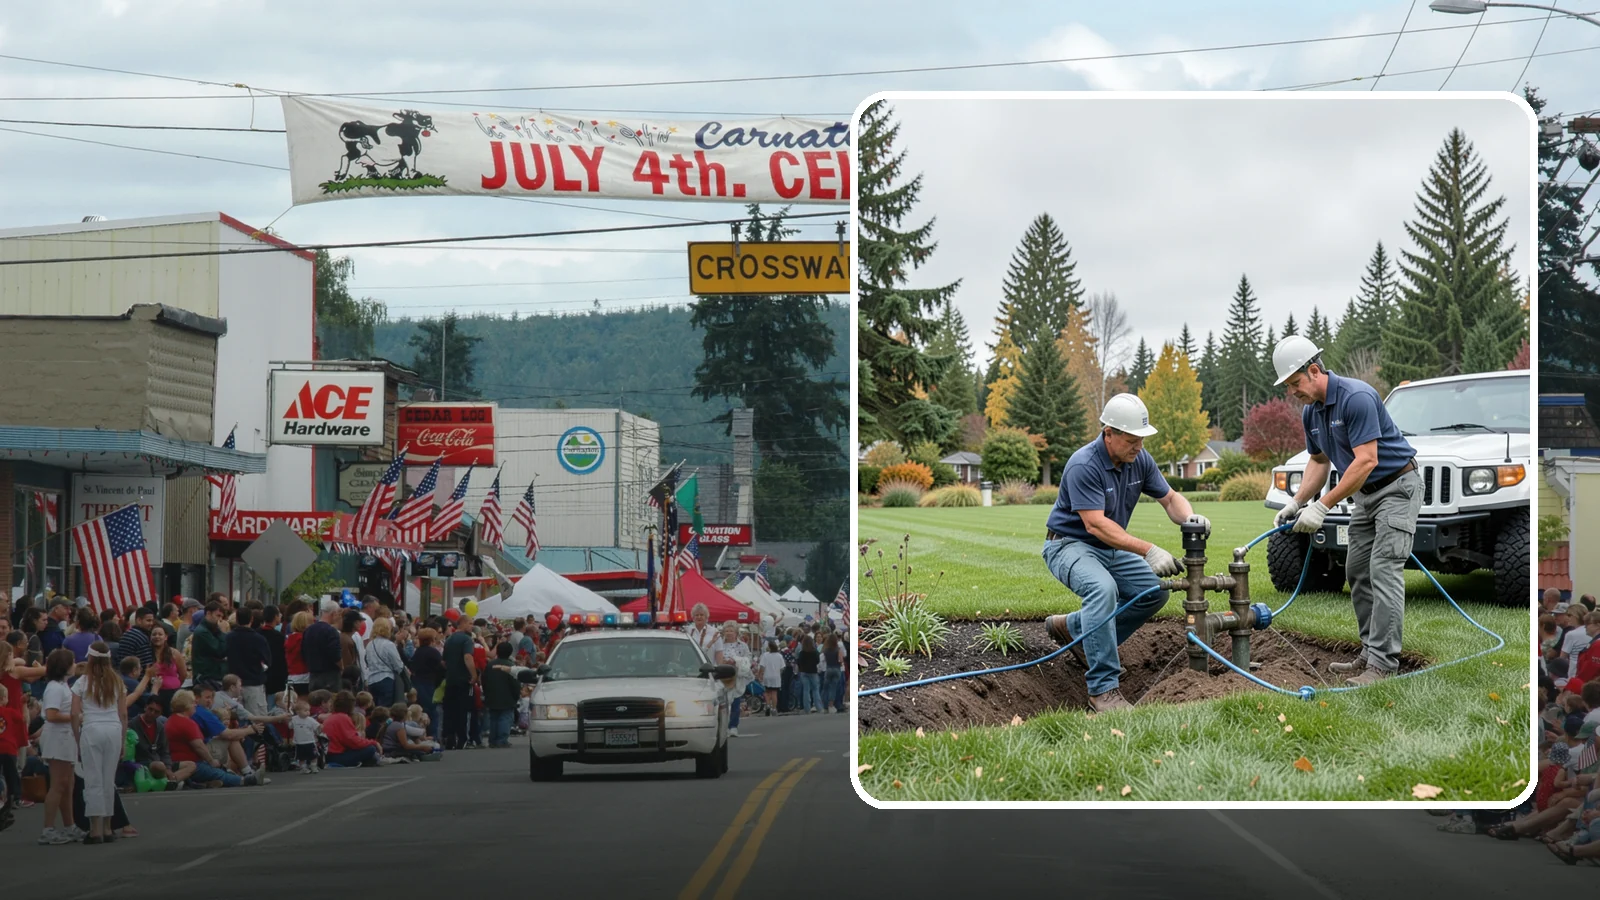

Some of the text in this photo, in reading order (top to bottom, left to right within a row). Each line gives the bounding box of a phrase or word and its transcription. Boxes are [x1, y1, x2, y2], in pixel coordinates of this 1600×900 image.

[481, 141, 604, 192] JULY
[633, 150, 746, 198] 4th.
[697, 254, 850, 280] CROSSWA
[283, 380, 373, 420] ACE
[405, 409, 485, 422] CEDAR LOG
[283, 421, 371, 436] Hardware
[416, 428, 477, 447] Coca-Cola
[353, 467, 386, 480] Simpl
[95, 485, 124, 495] Vincent
[126, 486, 136, 495] de
[137, 486, 155, 496] Paul
[81, 503, 154, 522] THRT
[212, 516, 331, 536] HARDARE
[688, 526, 741, 535] CRNATION
[699, 535, 730, 543] GLASS
